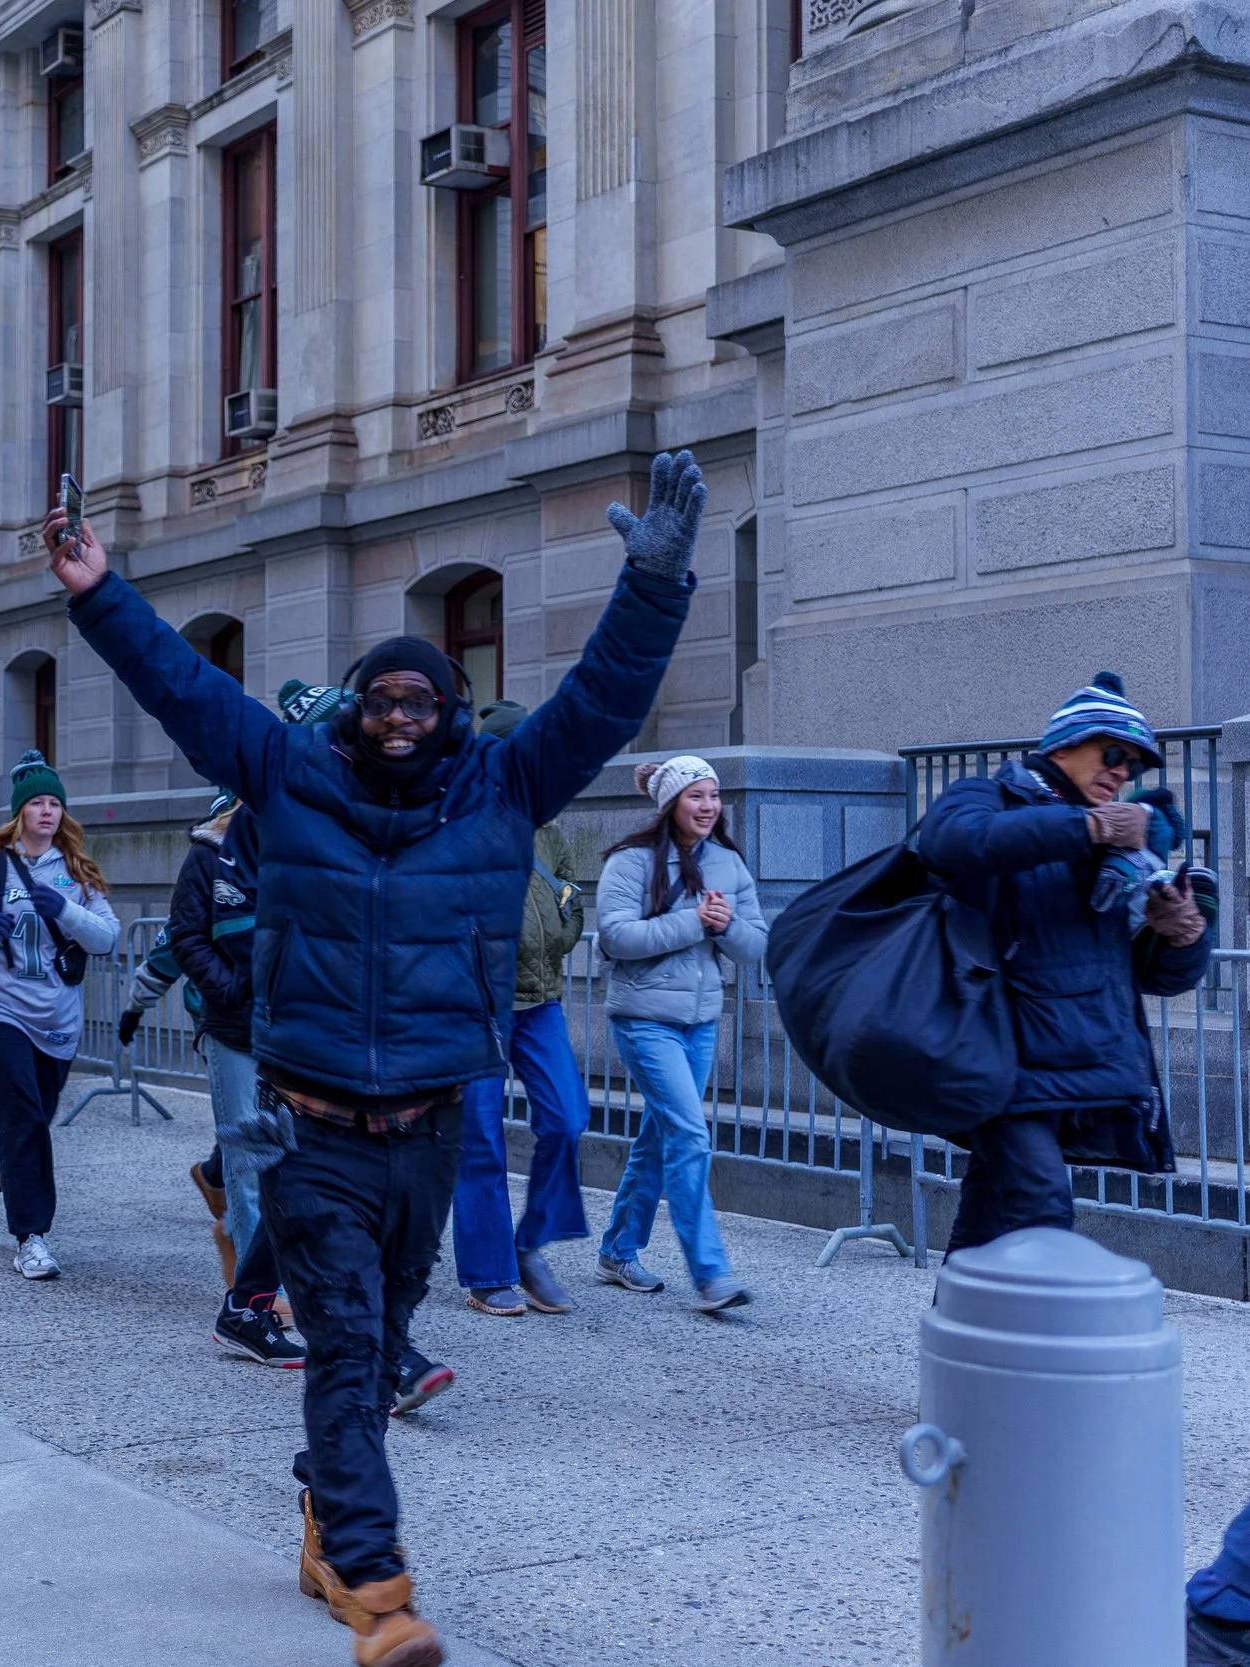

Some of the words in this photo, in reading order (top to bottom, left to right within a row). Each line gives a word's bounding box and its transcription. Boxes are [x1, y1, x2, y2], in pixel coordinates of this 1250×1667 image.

[287, 687, 334, 721] EAG
[6, 887, 31, 904] EAG
[11, 910, 47, 979] 1
